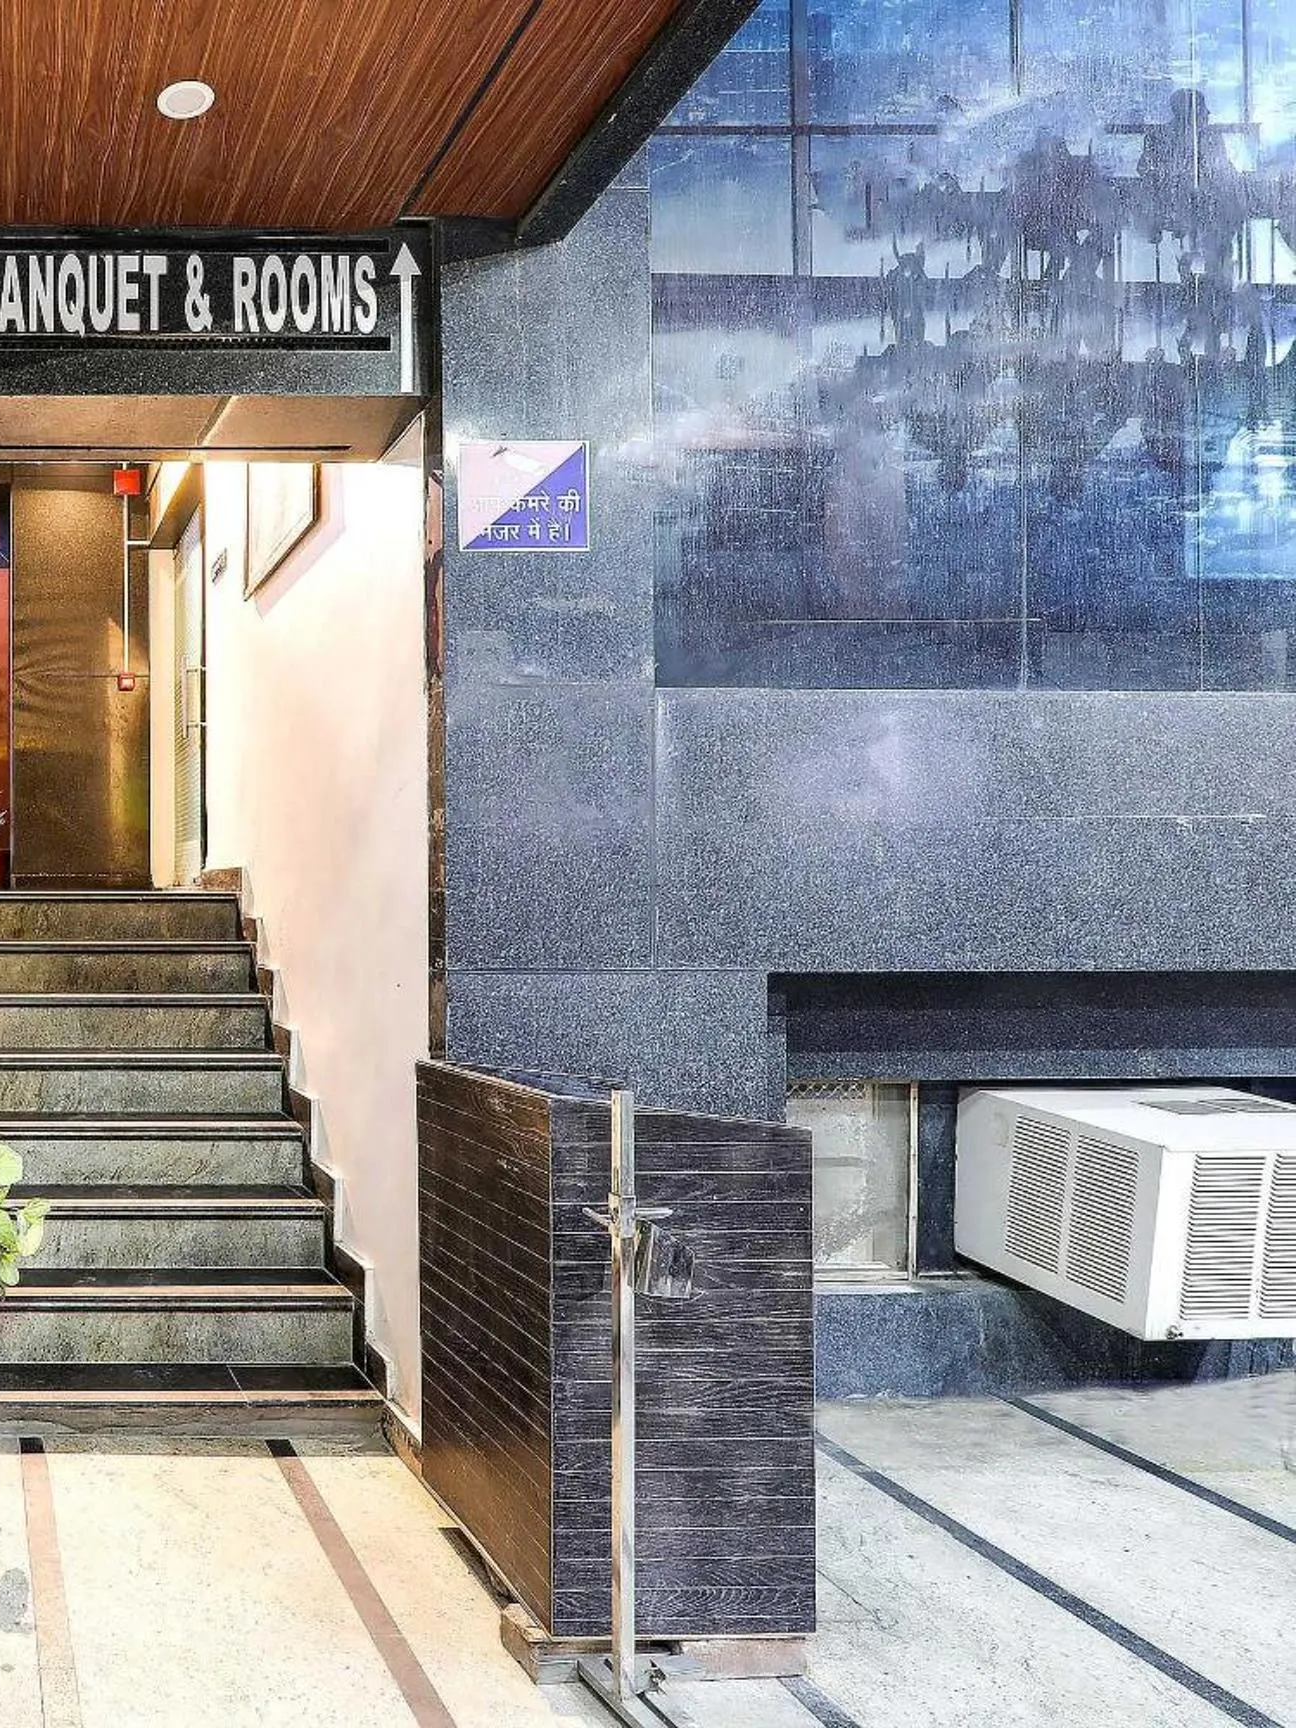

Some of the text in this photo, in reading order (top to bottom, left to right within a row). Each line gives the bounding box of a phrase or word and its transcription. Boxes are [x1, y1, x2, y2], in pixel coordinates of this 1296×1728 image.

[184, 254, 212, 332] &
[232, 255, 378, 335] ROOMS
[557, 488, 581, 513] की
